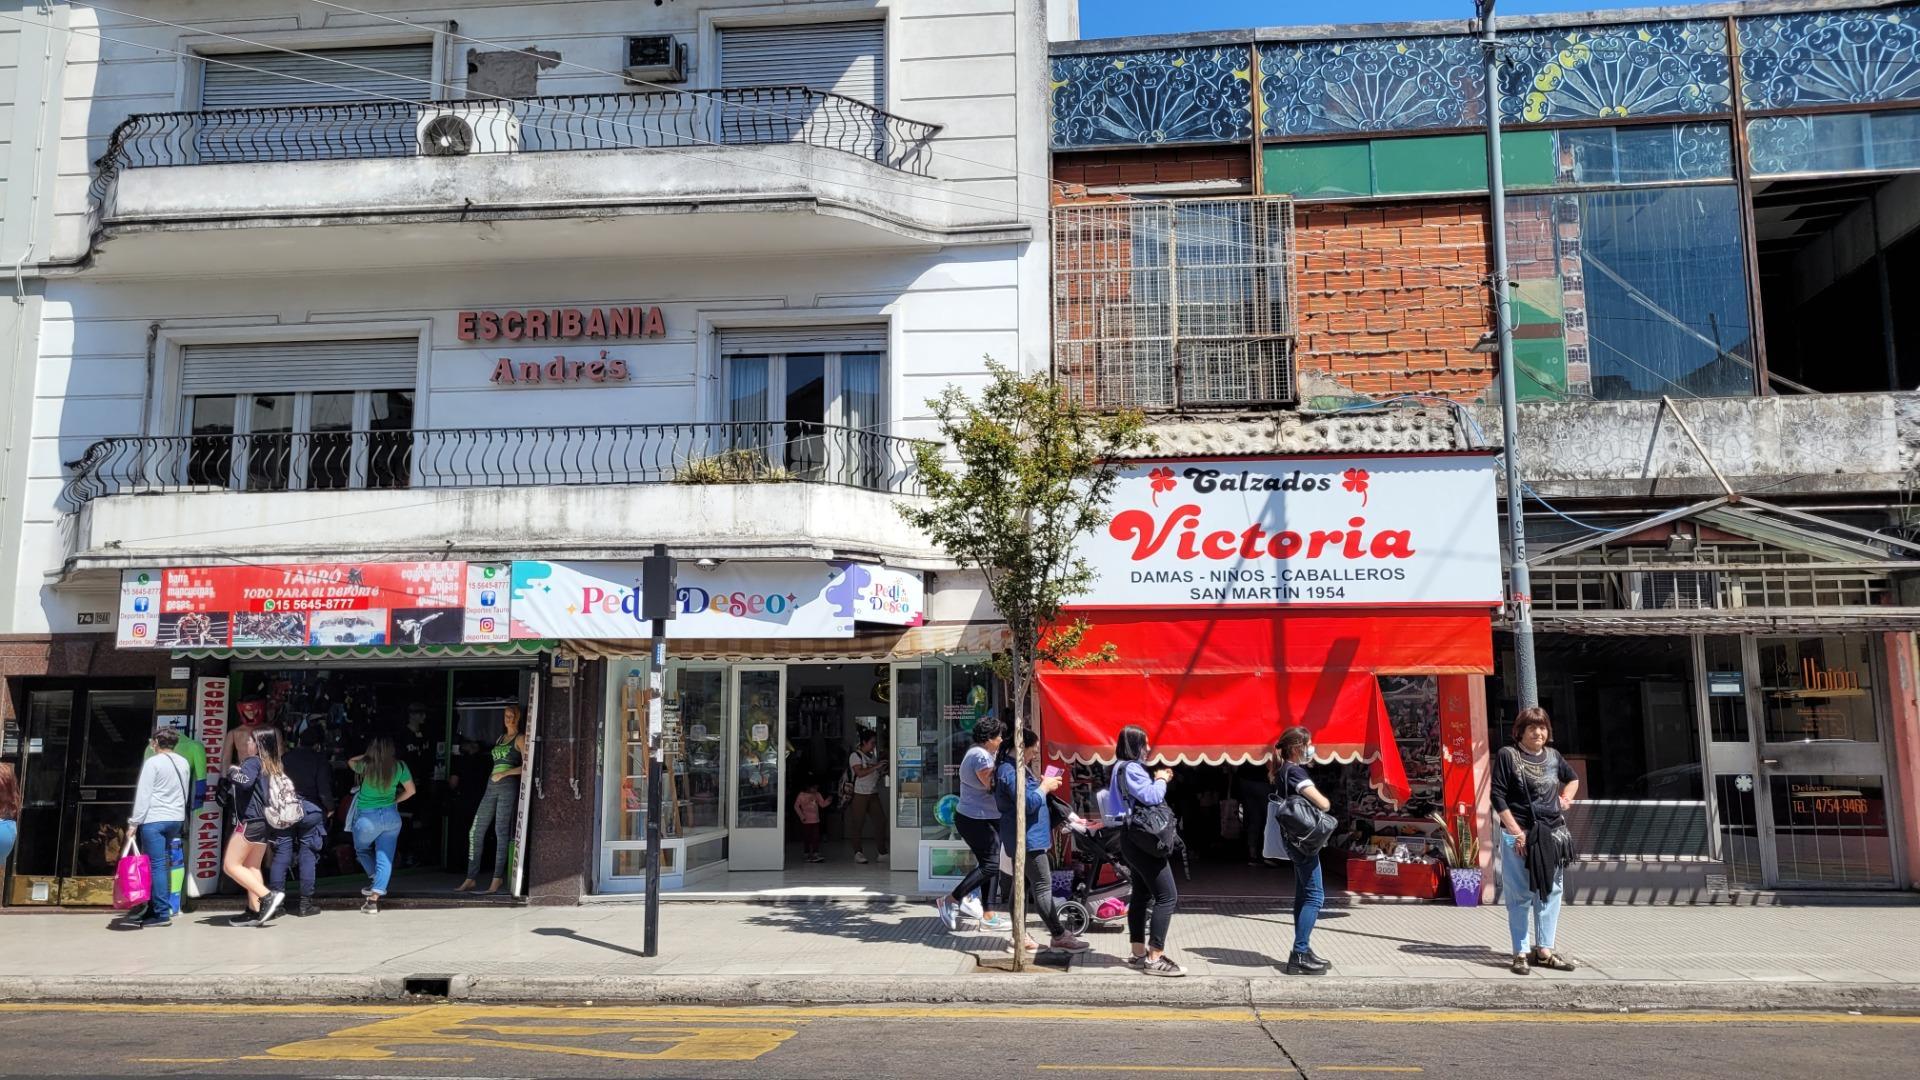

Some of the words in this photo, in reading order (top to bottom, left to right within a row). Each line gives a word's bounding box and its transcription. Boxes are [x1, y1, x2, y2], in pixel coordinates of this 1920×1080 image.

[458, 306, 666, 341] ESCRIBANIA
[490, 350, 628, 383] Andrés
[1183, 467, 1331, 493] Calzados
[1109, 504, 1416, 561] Victoria
[1131, 570, 1194, 583] DAMAS
[1210, 567, 1265, 582] NIÑOS
[1281, 567, 1406, 582] CABALLEROS
[243, 588, 273, 599] TODO
[276, 587, 309, 598] PARA
[276, 600, 290, 610] 15
[293, 598, 354, 610] 5645-8777
[581, 587, 648, 622] Ped
[1190, 587, 1226, 600] SAN
[1232, 583, 1300, 600] MARTÍN
[1306, 585, 1346, 599] 1954
[202, 681, 226, 774] COMPOSTURA
[1816, 798, 1869, 814] 4754-9466
[197, 812, 220, 878] CALZADO
